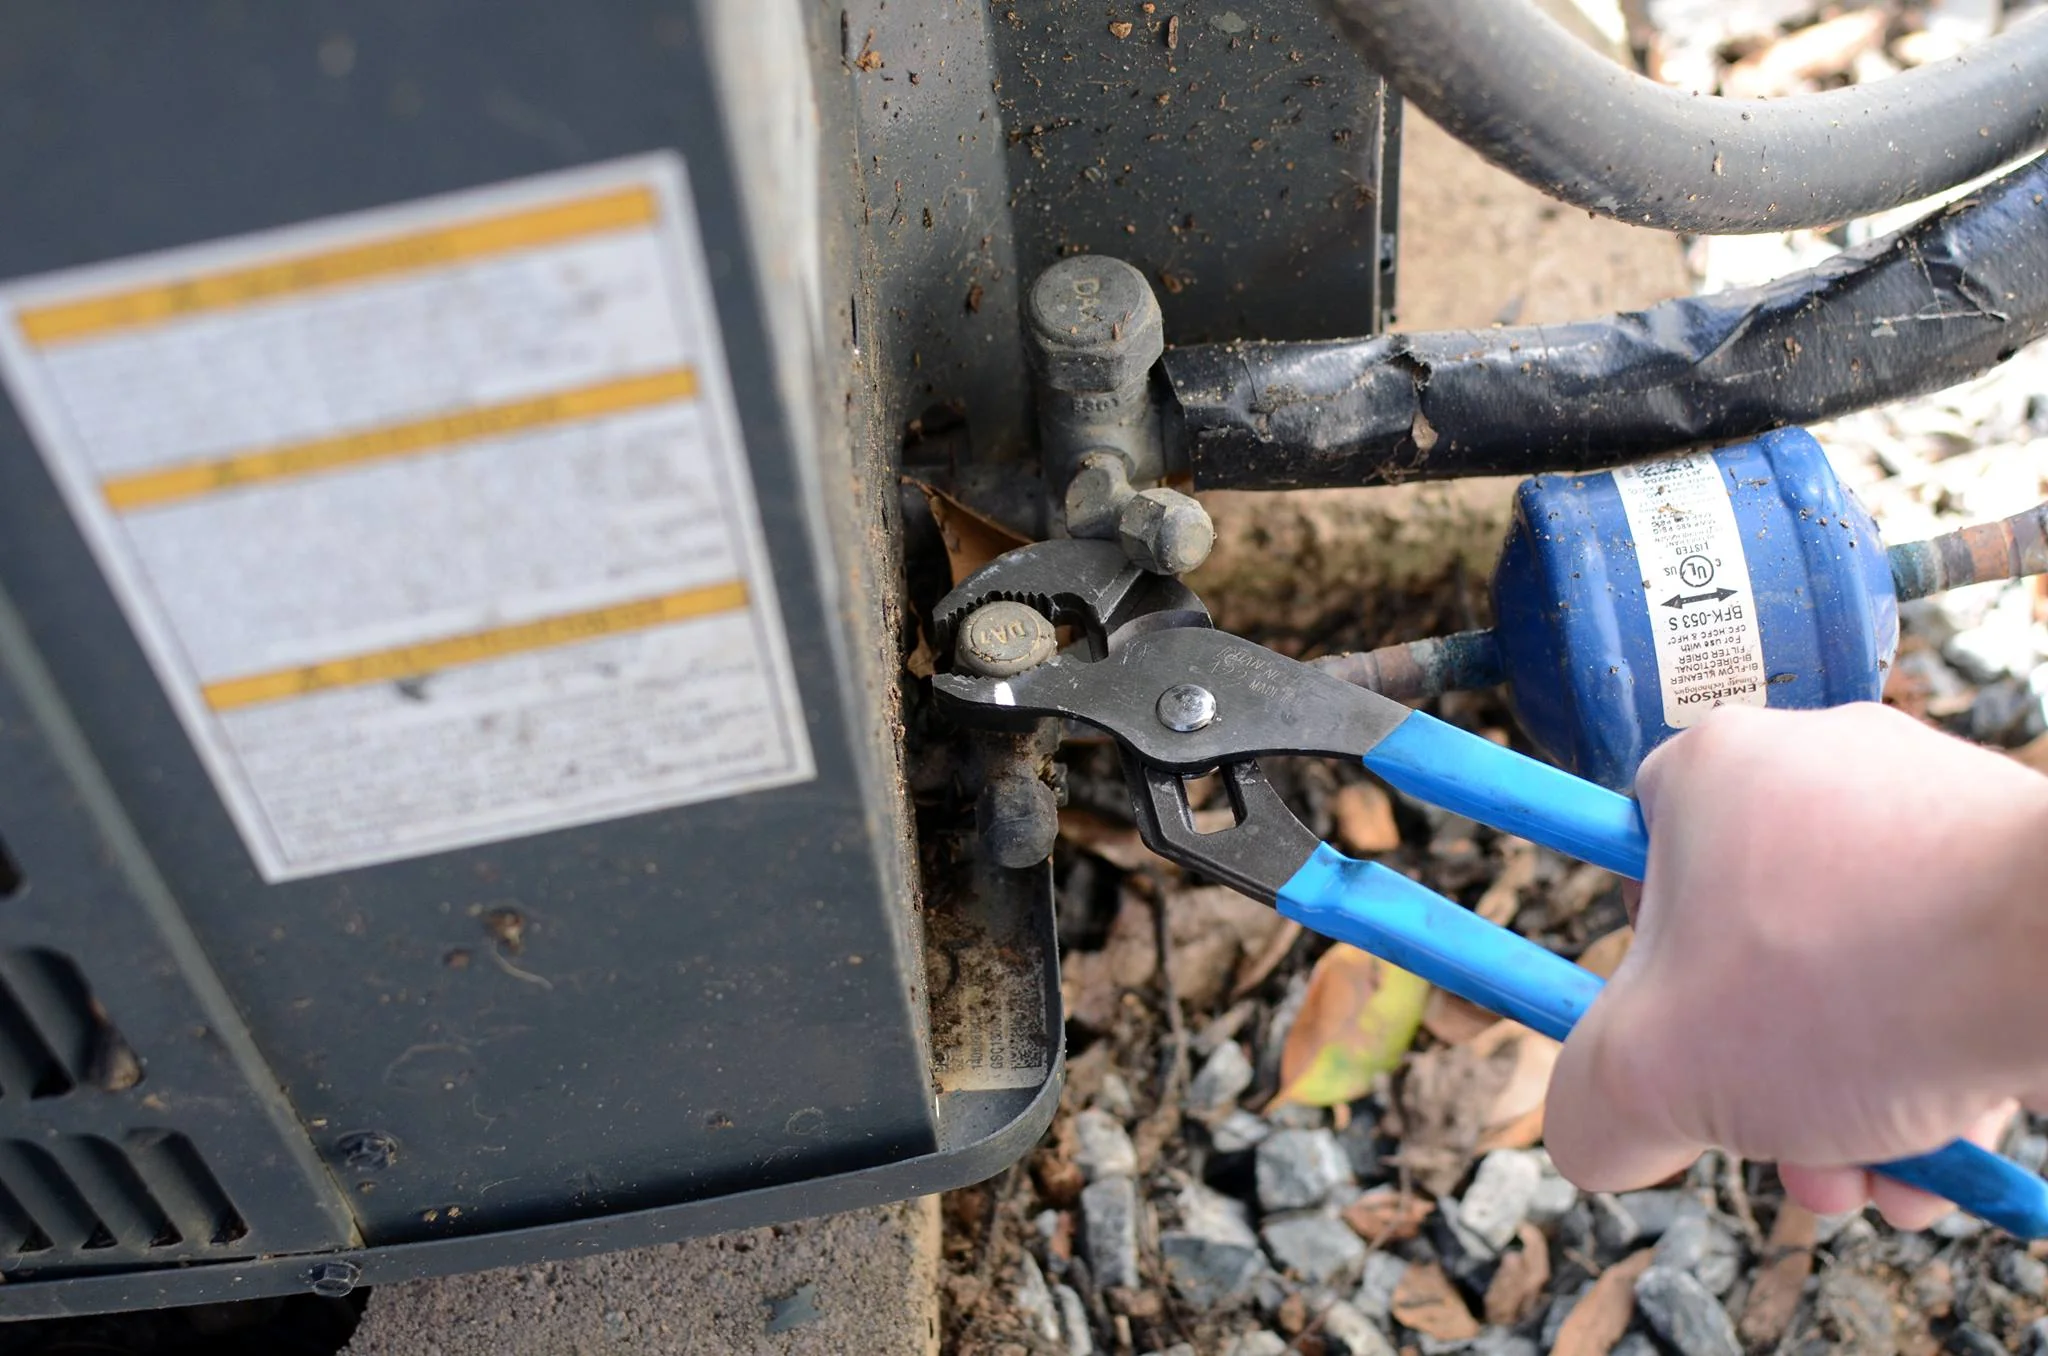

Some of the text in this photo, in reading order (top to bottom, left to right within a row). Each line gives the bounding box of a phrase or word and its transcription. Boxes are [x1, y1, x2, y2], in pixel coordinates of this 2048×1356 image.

[1675, 541, 1709, 556] LISTED
[1664, 558, 1722, 579] C UL US
[1668, 605, 1743, 631] BFK-053 S
[1680, 635, 1741, 652] For use with
[1674, 654, 1752, 674] BI-DIRECTIONAL
[1679, 646, 1745, 665] FILTER DRIER
[1670, 662, 1759, 685] BI-FLOW KLEANER
[1674, 676, 1758, 695] Climate Technologies
[1677, 683, 1757, 705] EMERSON
